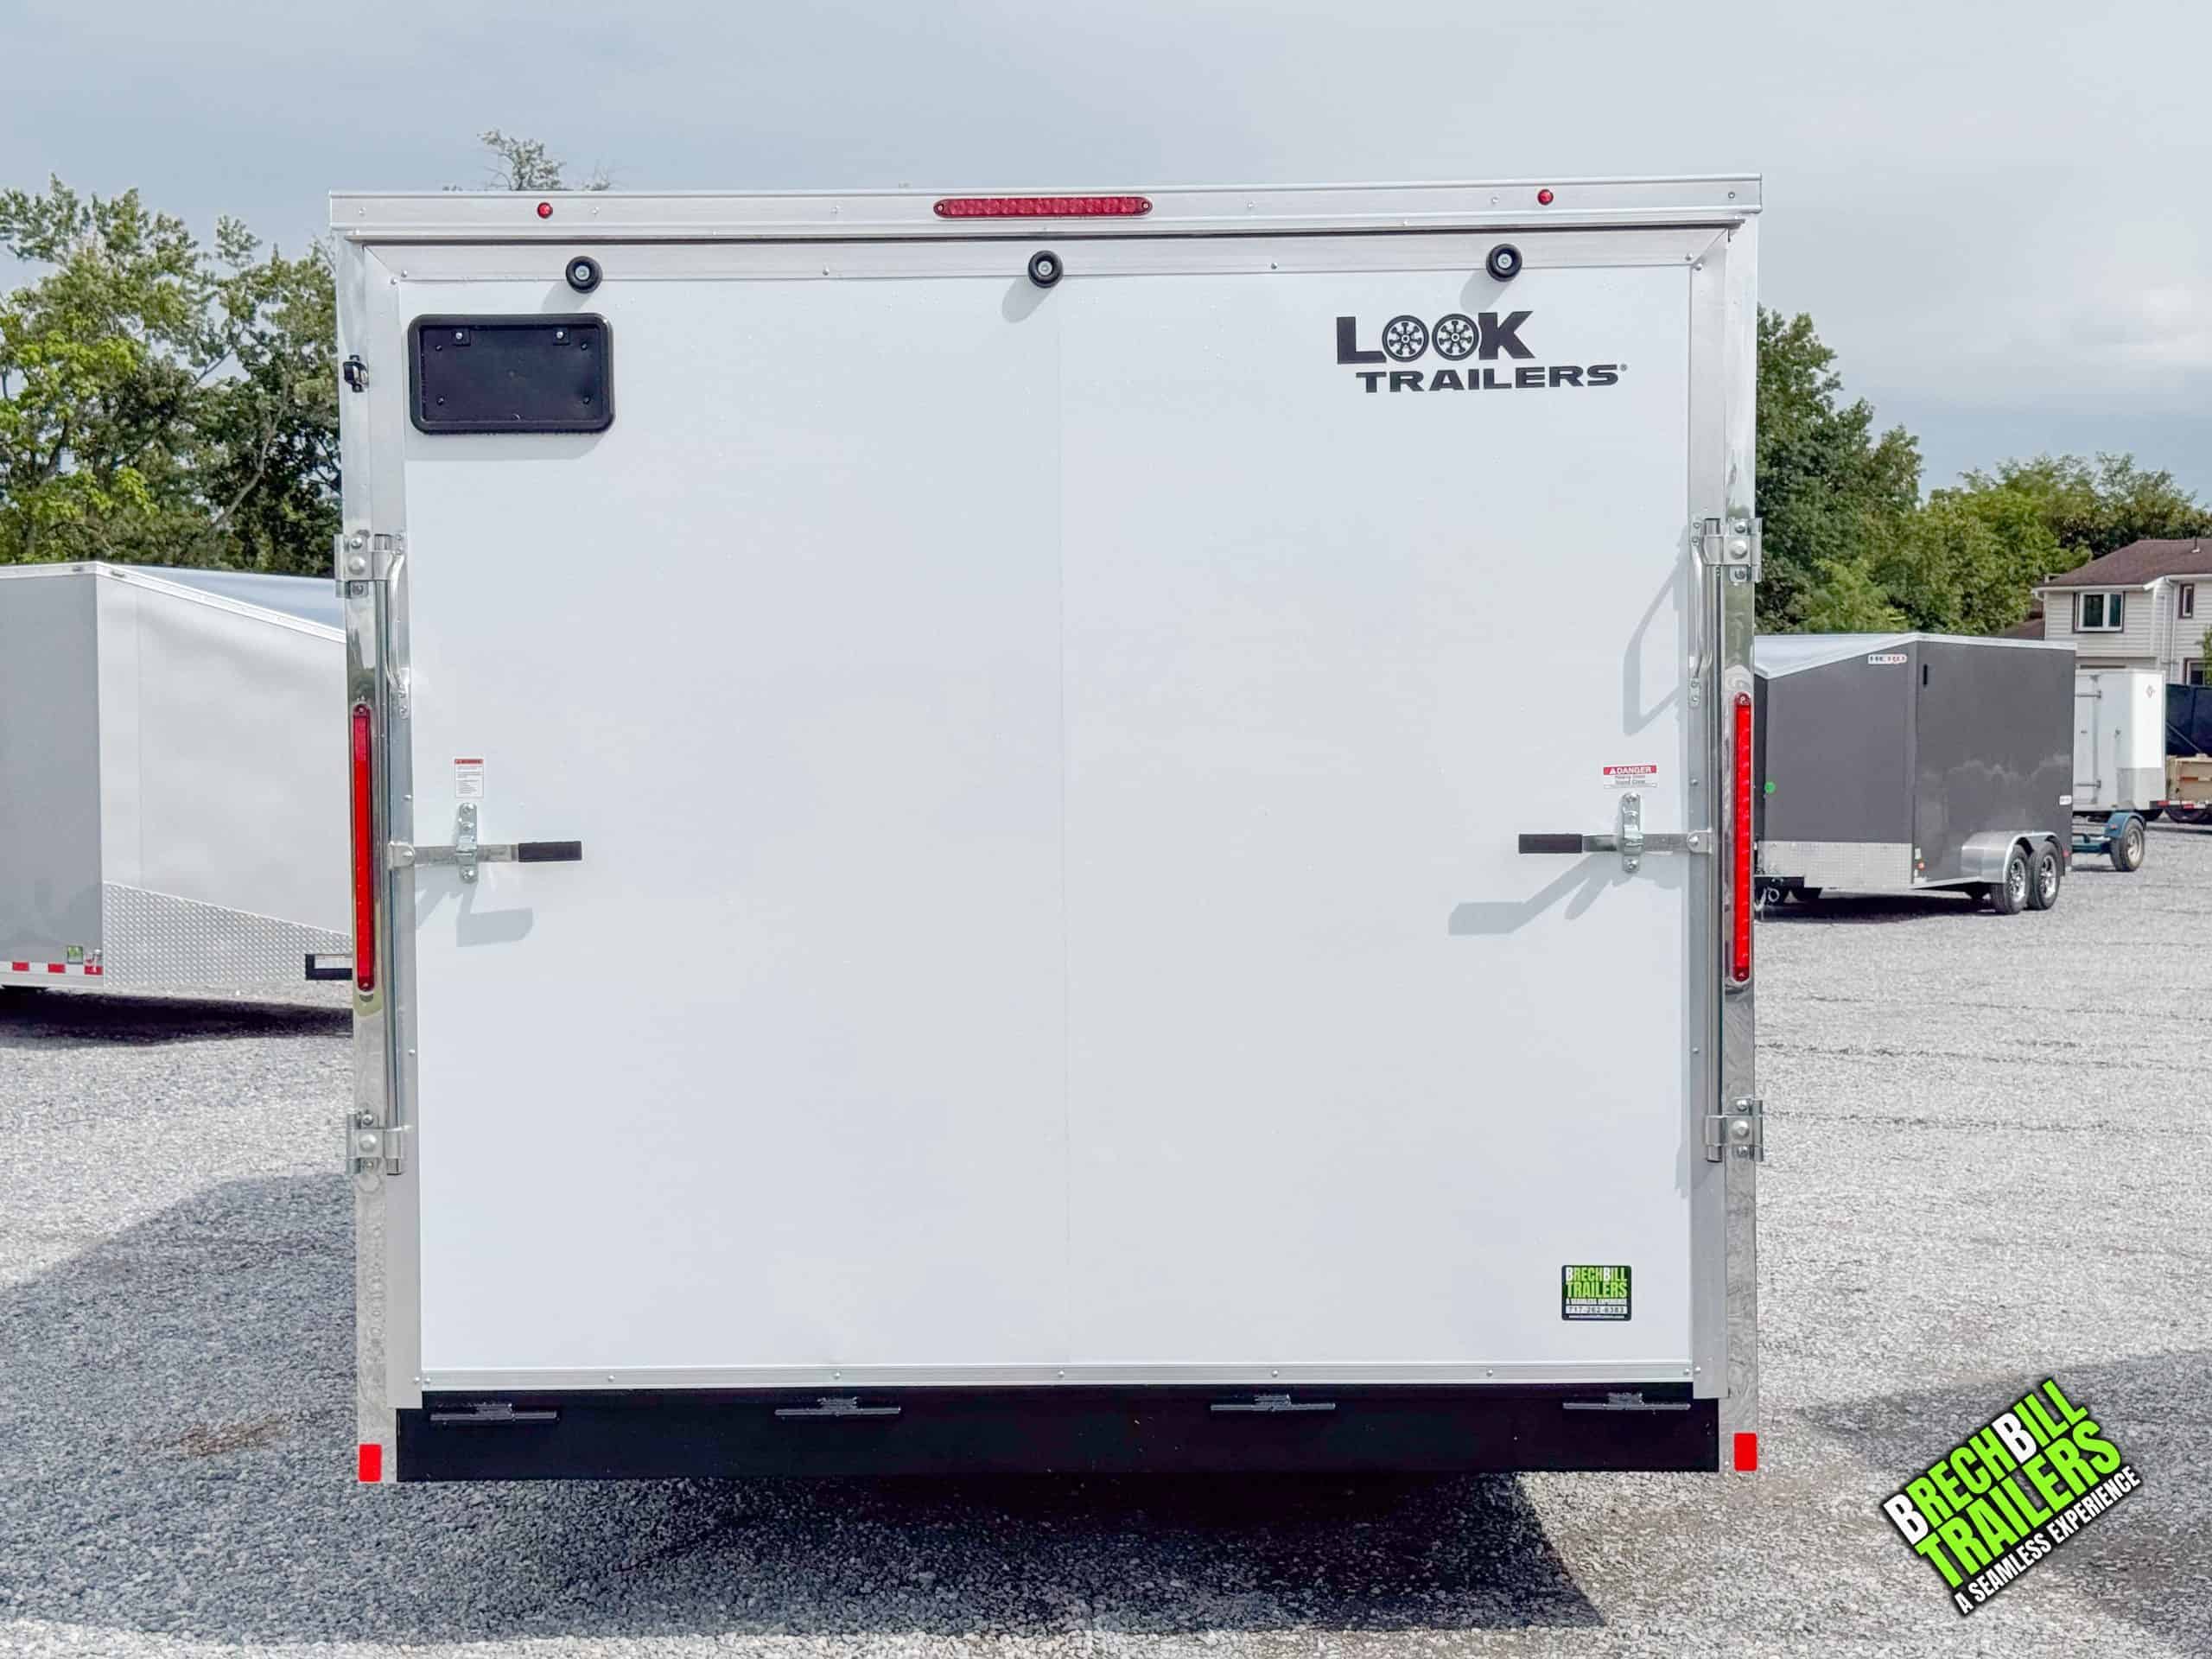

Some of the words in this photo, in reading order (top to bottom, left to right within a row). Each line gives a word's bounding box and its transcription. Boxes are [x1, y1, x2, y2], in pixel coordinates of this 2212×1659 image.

[1337, 311, 1535, 365] LOOK
[1617, 766, 1652, 775] DANGER
[1566, 1267, 1627, 1281] BRECHBILL
[1566, 1281, 1627, 1298] TRAILERS
